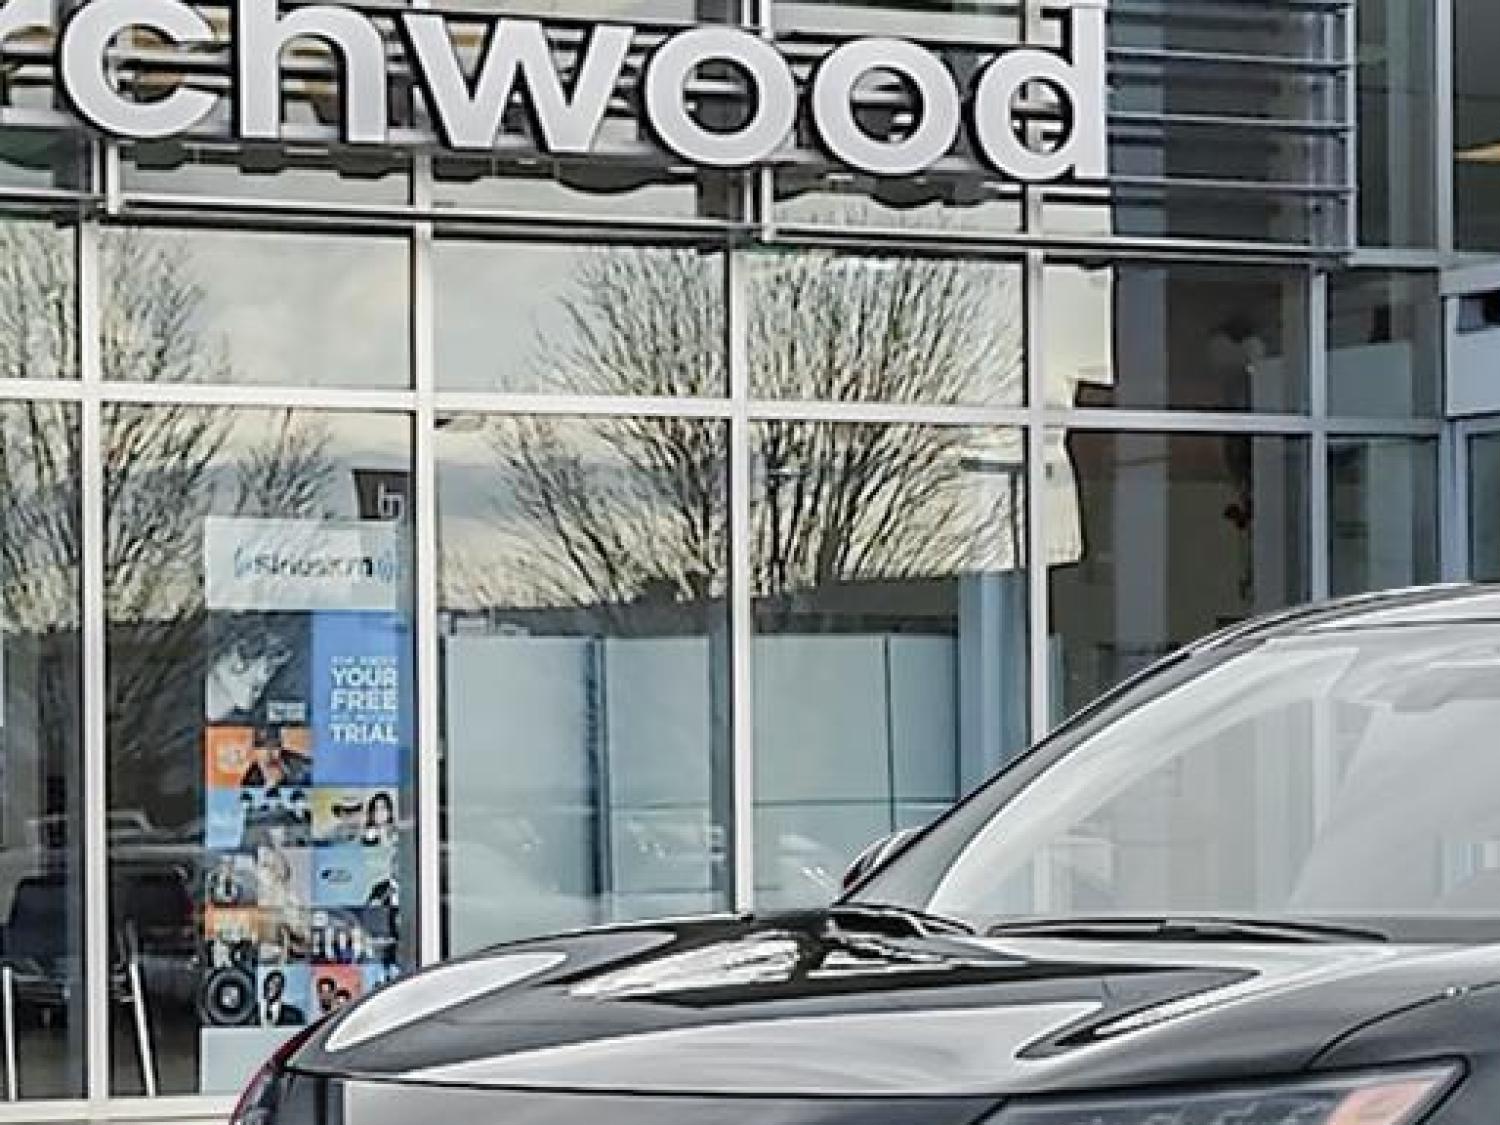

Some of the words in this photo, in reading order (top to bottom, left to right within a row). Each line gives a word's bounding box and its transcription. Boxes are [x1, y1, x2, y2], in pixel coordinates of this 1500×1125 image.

[331, 667, 398, 687] YOUR
[331, 689, 398, 710] FREE
[329, 723, 398, 744] TRIAL
